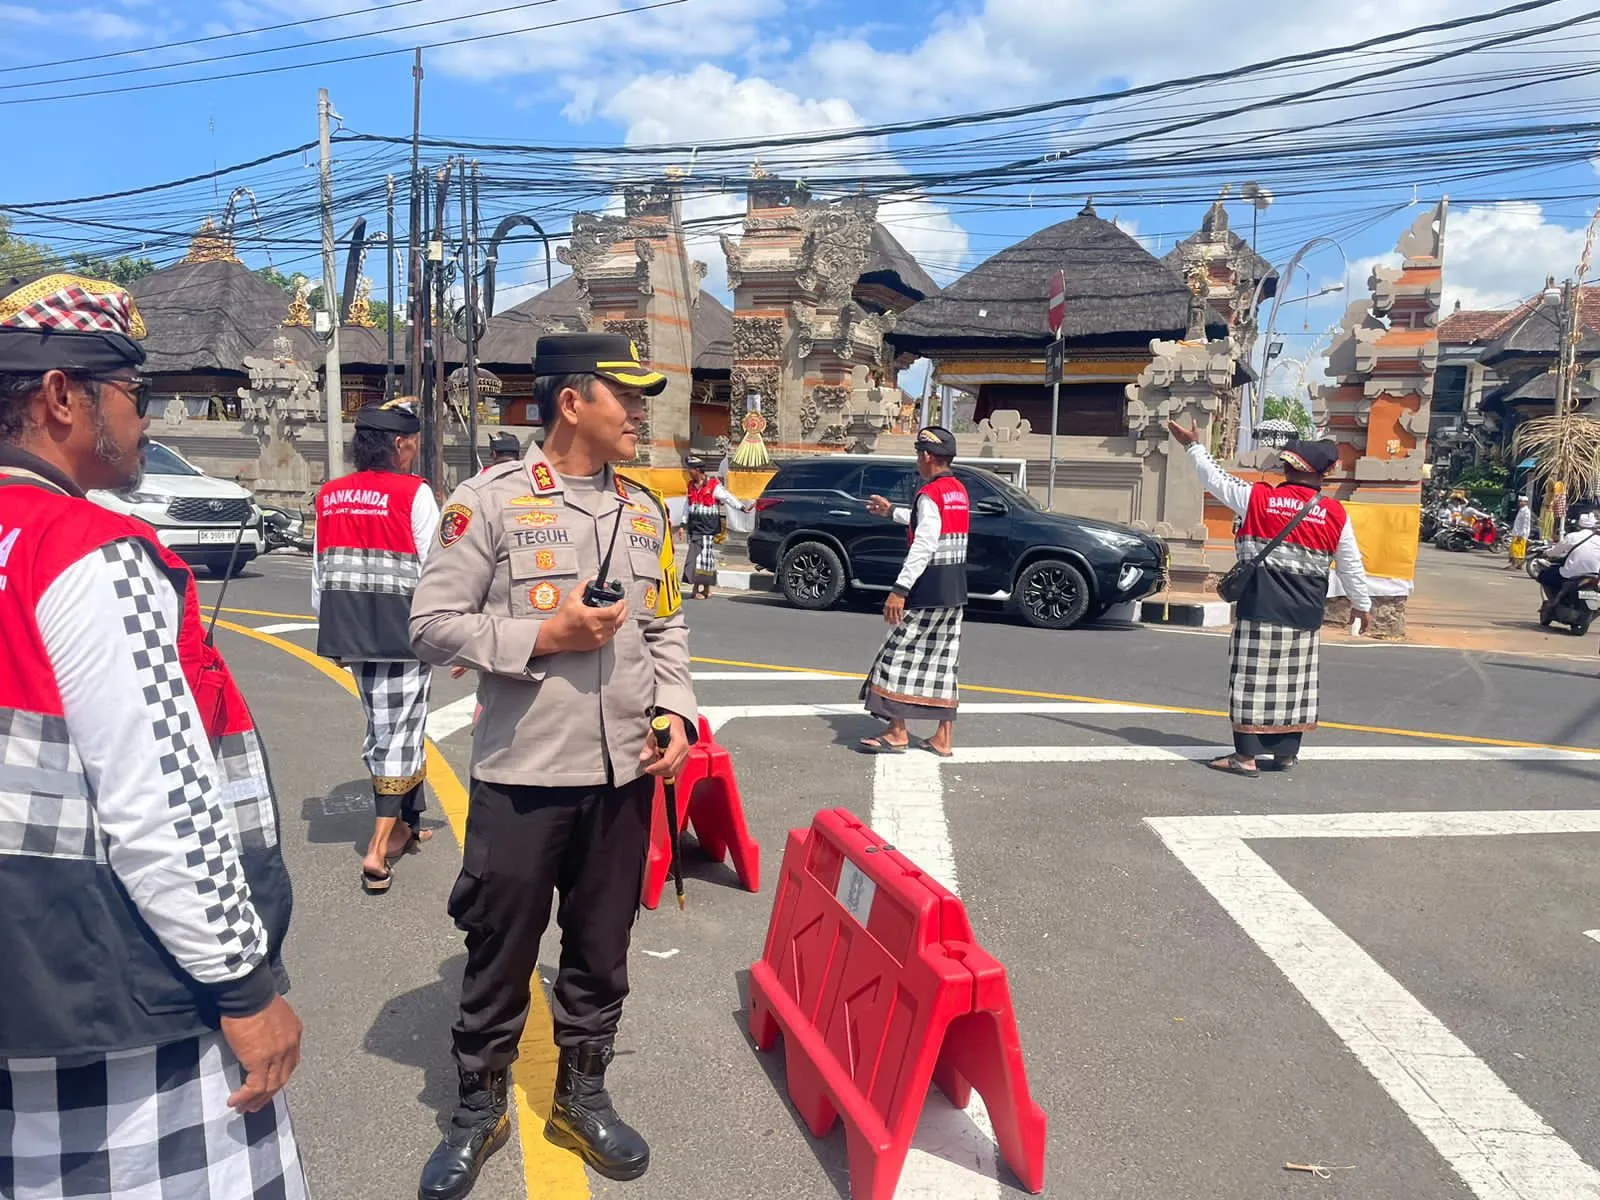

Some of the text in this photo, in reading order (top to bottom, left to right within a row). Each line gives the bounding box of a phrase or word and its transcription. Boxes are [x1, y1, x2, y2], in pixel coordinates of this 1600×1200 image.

[323, 489, 389, 508] BANKAMDA
[1268, 497, 1327, 519] BANKADA
[513, 529, 569, 546] TEGUH
[630, 535, 660, 556] POLRI
